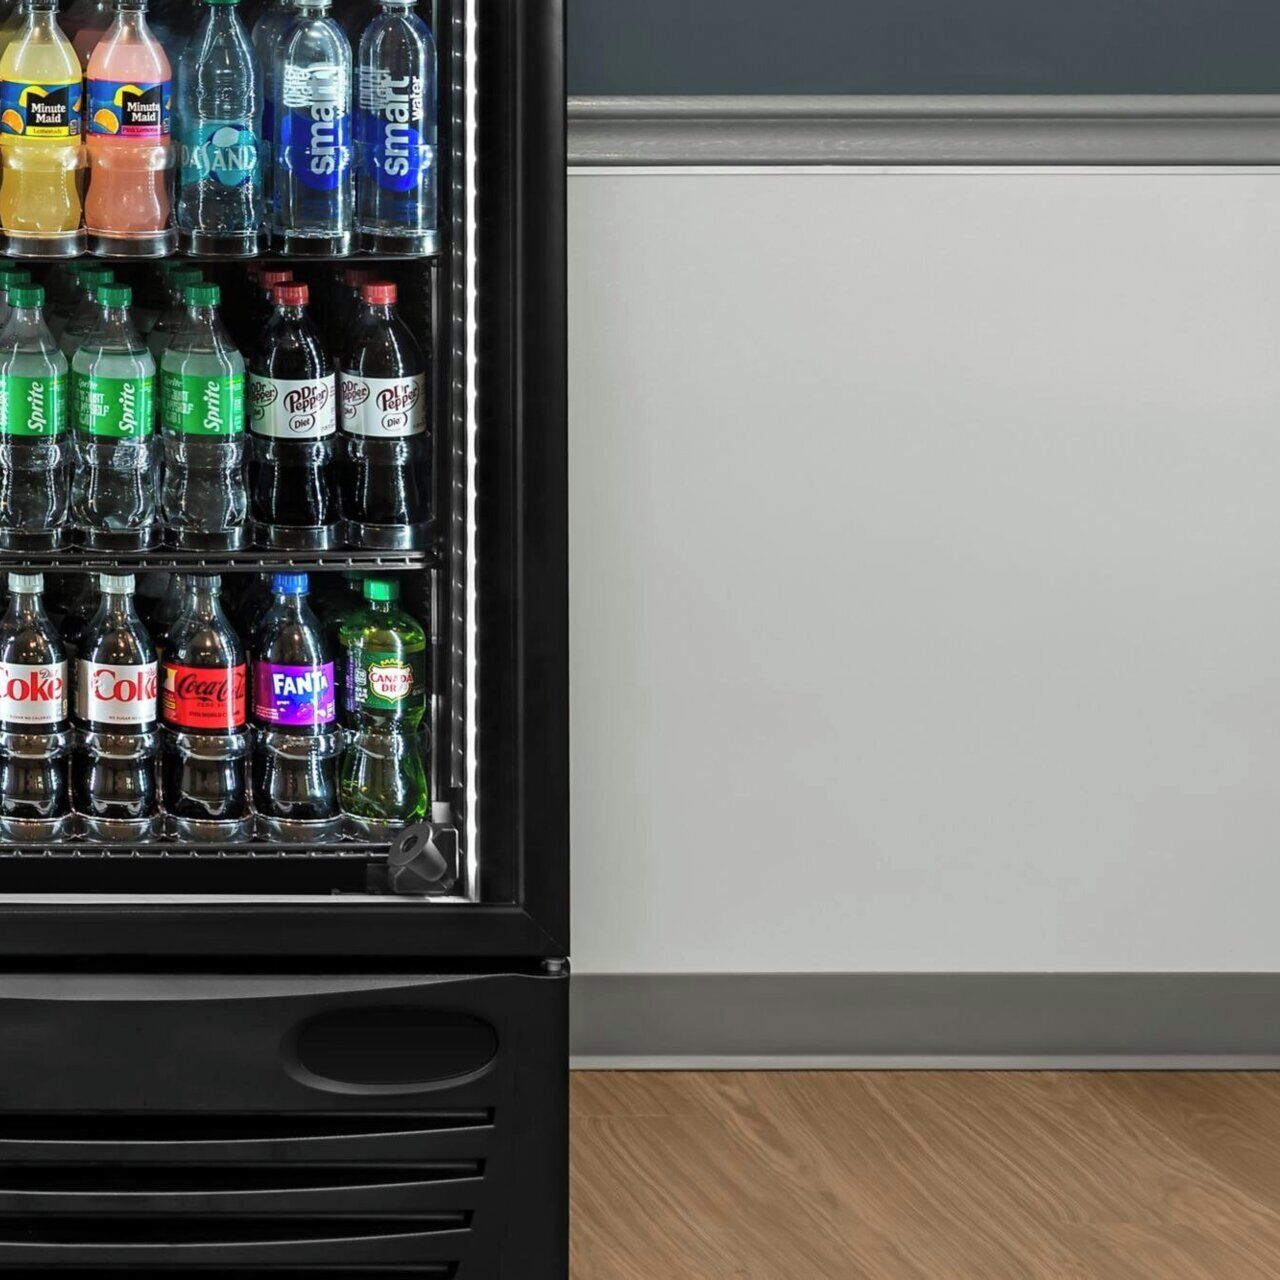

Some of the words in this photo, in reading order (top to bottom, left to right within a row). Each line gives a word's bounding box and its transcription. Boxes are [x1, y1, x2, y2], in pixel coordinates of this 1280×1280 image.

[31, 103, 66, 113] Minute
[35, 113, 61, 123] Maid
[127, 102, 159, 113] Minute
[131, 112, 156, 122] Maid
[384, 75, 409, 176] smart
[289, 389, 327, 414] Pepper
[301, 386, 318, 399] Dr
[380, 388, 418, 412] Pepper
[27, 381, 44, 432] Sprite
[119, 382, 136, 433] Sprite
[203, 381, 221, 432] Sprite
[294, 417, 310, 429] Diet
[273, 670, 328, 696] FANTA
